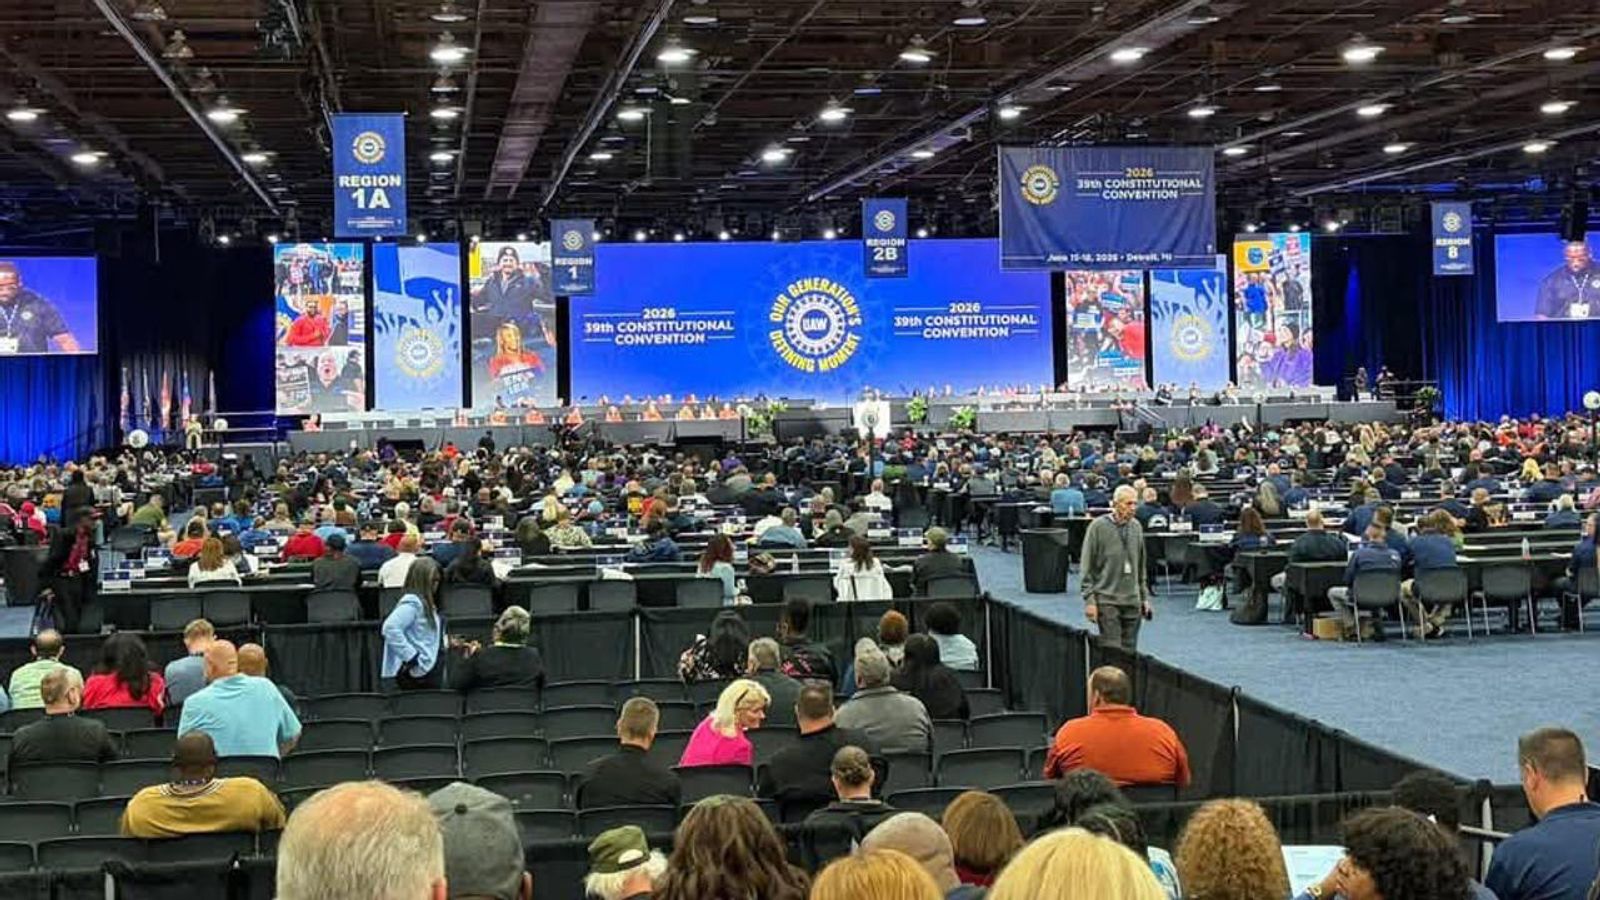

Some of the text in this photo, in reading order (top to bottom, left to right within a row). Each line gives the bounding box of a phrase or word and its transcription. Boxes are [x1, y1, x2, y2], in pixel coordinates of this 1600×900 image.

[1126, 168, 1154, 177] 2026
[339, 175, 401, 187] REGION
[1077, 178, 1203, 189] 39th CONSTITUTIONAL
[351, 188, 391, 208] 1A
[1102, 190, 1178, 199] CONVENTION
[866, 238, 905, 246] REGION
[1435, 238, 1470, 246] REGION
[873, 247, 898, 260] 2B
[1448, 246, 1458, 259] 8
[554, 257, 593, 265] REGION
[568, 266, 578, 280] 1
[769, 276, 863, 326] OUR GENERATION'S
[643, 308, 676, 319] 2026
[949, 302, 981, 313] 2026
[584, 320, 734, 333] 39th CONSTITUTIONAL
[802, 316, 828, 331] UAW
[893, 314, 1038, 327] 39th CONSTITUTIONAL
[614, 333, 705, 345] CONVENTION
[923, 327, 1009, 339] CONVENTION
[769, 330, 862, 372] DEFINING MOMENT
